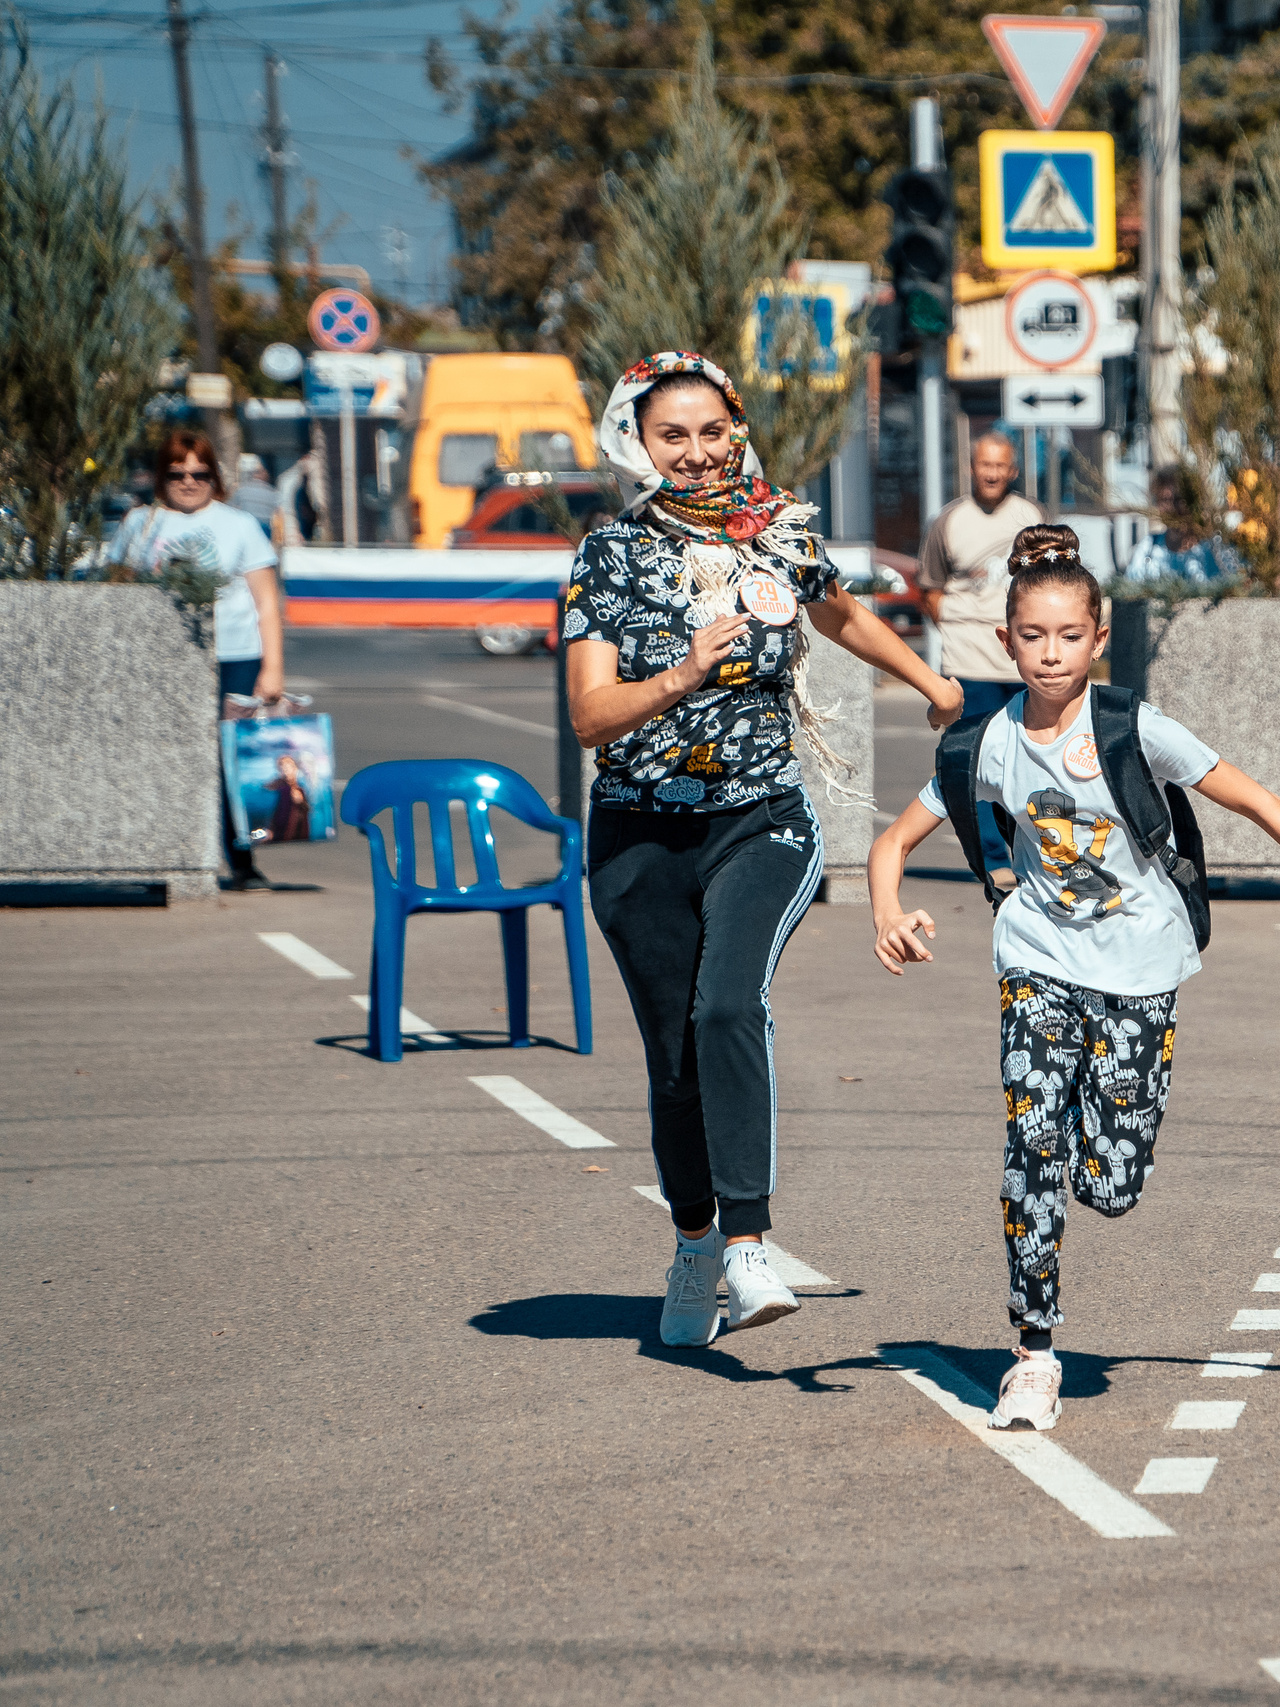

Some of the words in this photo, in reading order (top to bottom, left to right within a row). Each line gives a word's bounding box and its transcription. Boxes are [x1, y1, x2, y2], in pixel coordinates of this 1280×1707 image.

[754, 581, 779, 601] 29
[589, 590, 616, 609] AYE
[751, 600, 790, 614] ШКОЛА
[646, 633, 680, 646] Bart
[644, 654, 671, 666] WHO
[670, 643, 690, 658] THE
[720, 662, 753, 677] EAT
[1067, 751, 1098, 773] ШКОЛА
[663, 786, 701, 800] COW
[1012, 993, 1050, 1018] HELL
[1044, 1007, 1069, 1019] WHO
[1027, 1012, 1046, 1027] THE
[1038, 1027, 1063, 1041] Bart
[1090, 1052, 1120, 1076] HELL
[1097, 1074, 1115, 1089] THE
[1114, 1068, 1140, 1081] WHO
[1107, 1089, 1138, 1103] Bart
[1023, 1125, 1042, 1145] THE
[1109, 1193, 1133, 1209] WHO
[1021, 1253, 1039, 1271] THE
